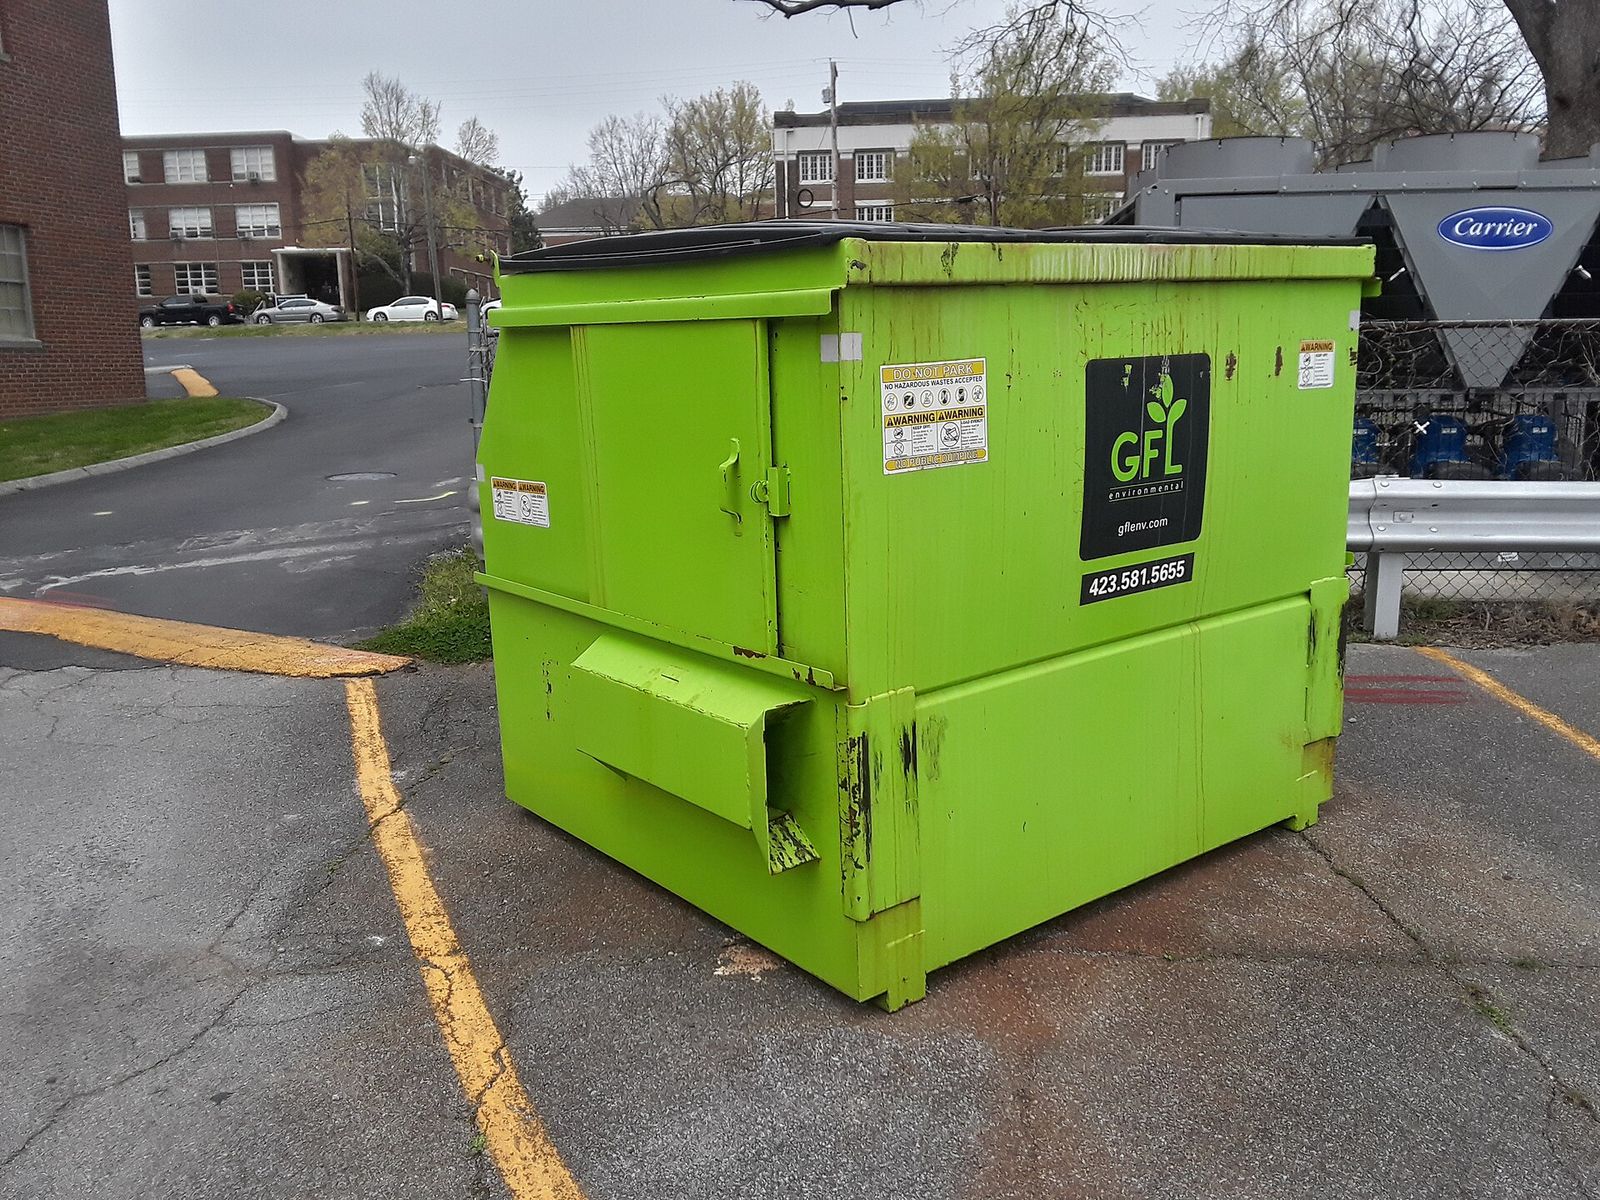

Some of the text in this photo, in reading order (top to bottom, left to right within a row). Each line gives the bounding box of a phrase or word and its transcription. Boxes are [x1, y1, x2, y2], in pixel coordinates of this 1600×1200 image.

[1454, 217, 1538, 236] Carrier
[1305, 342, 1333, 352] WARNING
[893, 363, 974, 380] DO NOT PARK
[894, 380, 930, 389] HAZARDOUS
[931, 378, 954, 386] WASTES
[954, 375, 983, 384] ACCEPTED
[893, 413, 935, 426] WARNING
[944, 408, 984, 421] WARNING
[1110, 399, 1187, 482] GFL
[895, 459, 908, 469] NO
[496, 480, 516, 490] WARNING
[522, 484, 545, 494] WARNING
[1108, 480, 1184, 500] environmental
[1117, 516, 1169, 537] gflenv.com
[1089, 560, 1186, 597] 423.581.5655
